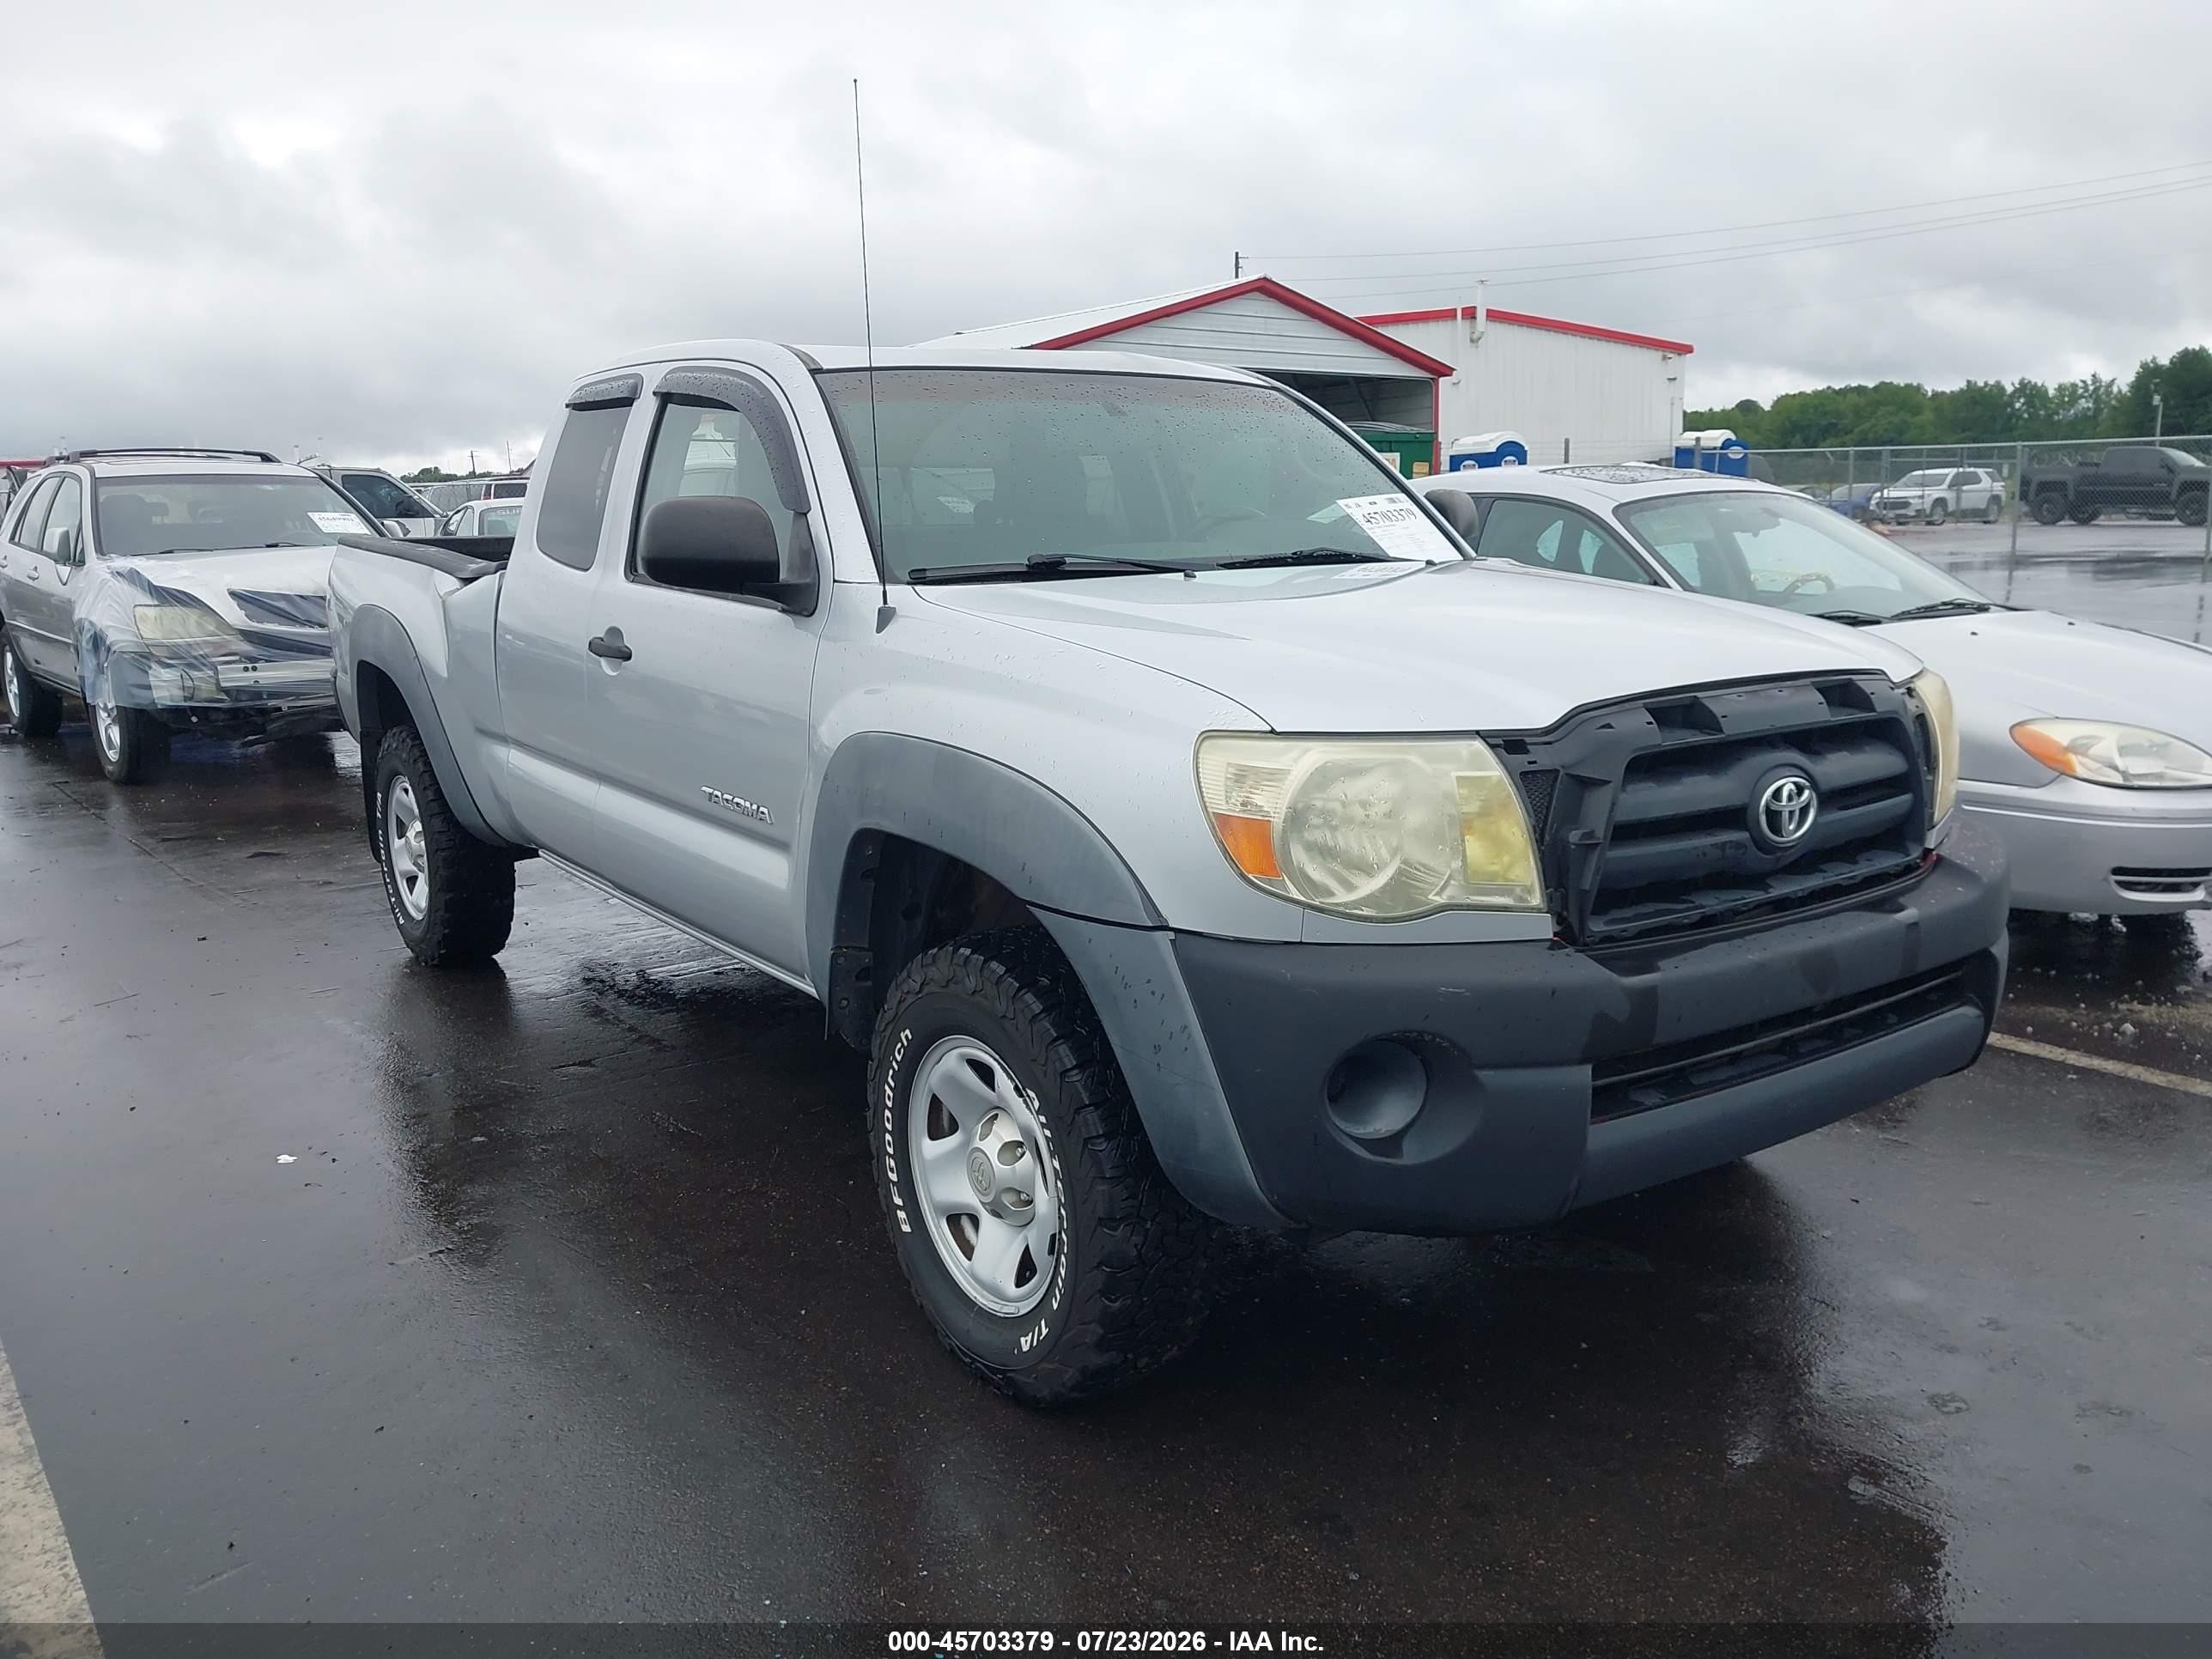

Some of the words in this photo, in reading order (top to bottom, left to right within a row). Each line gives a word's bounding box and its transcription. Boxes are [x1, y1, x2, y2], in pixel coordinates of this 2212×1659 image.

[1362, 507, 1417, 525] 45703379
[700, 785, 774, 824] TACOMA
[884, 1028, 913, 1233] BFGoodrich
[1019, 1317, 1049, 1352] T/A
